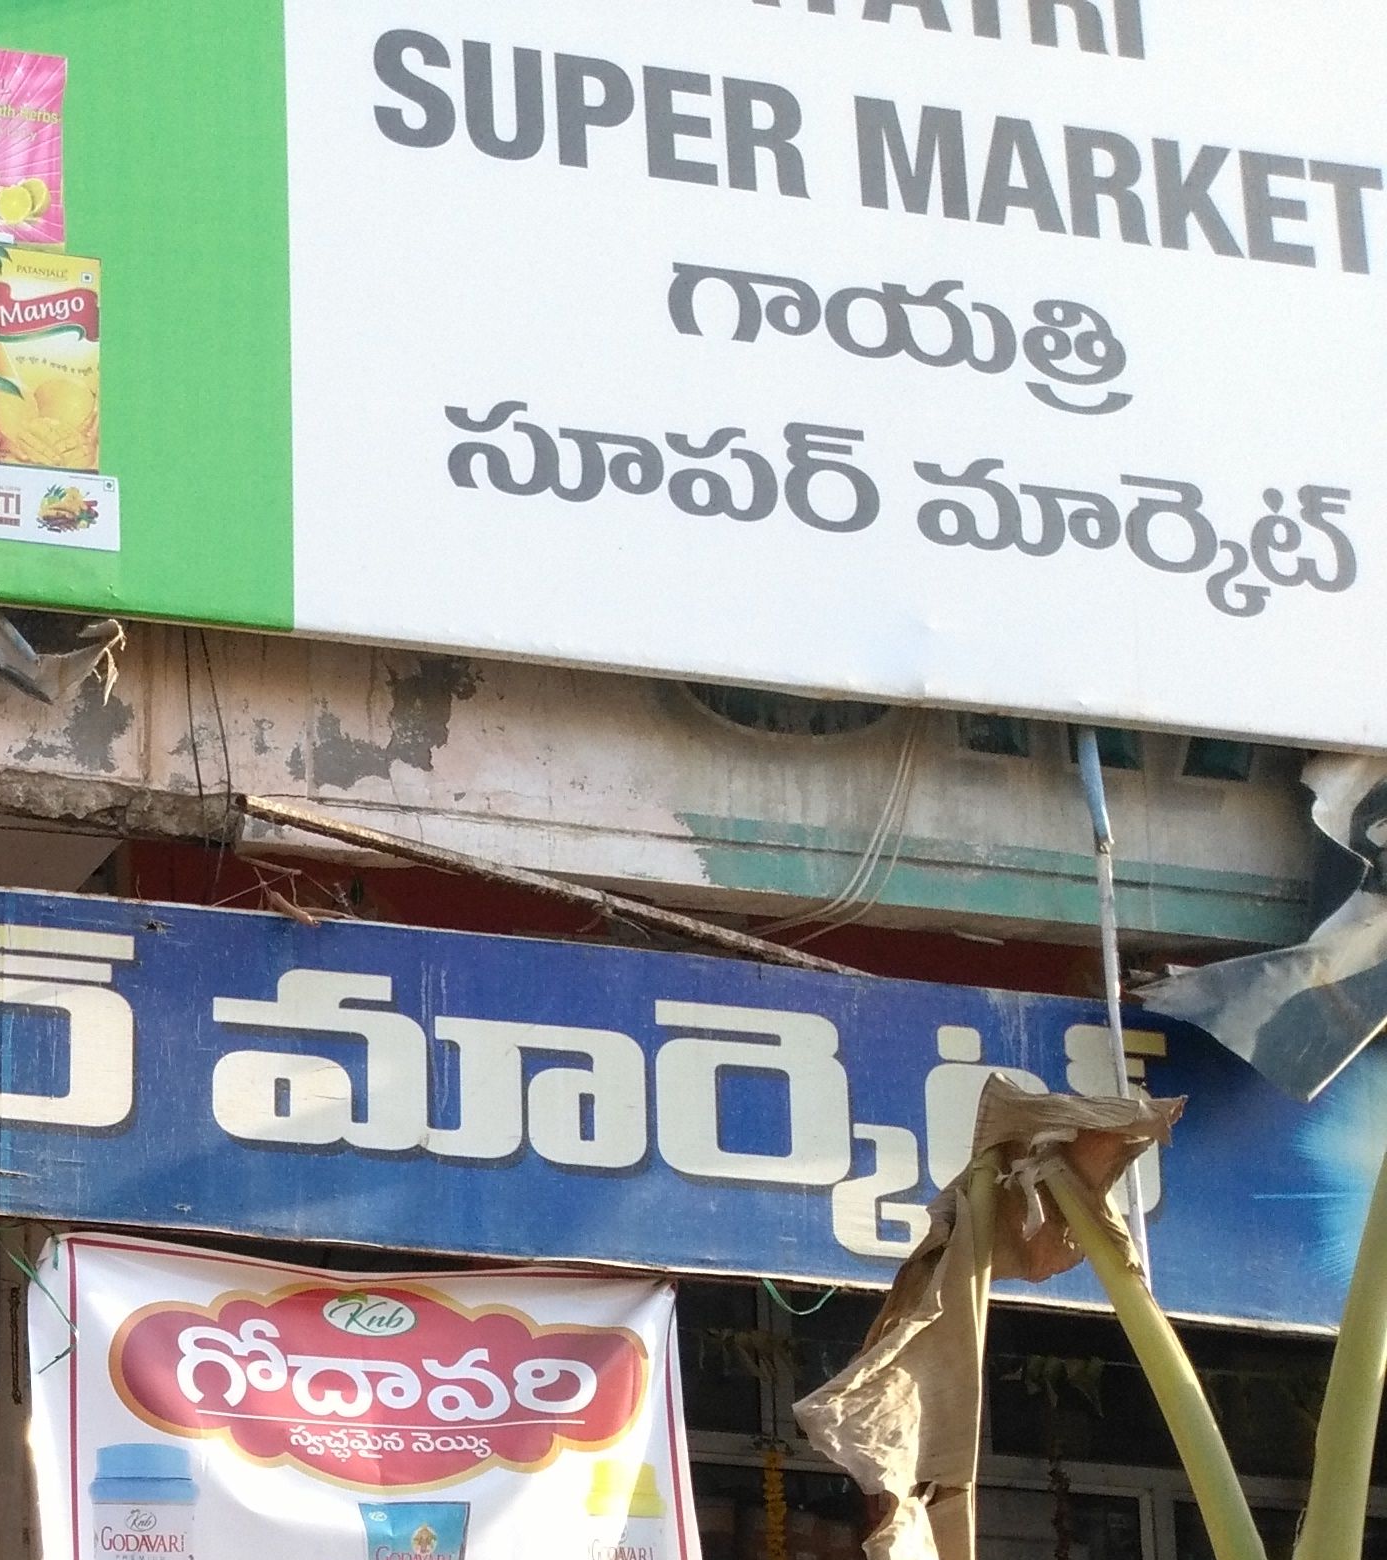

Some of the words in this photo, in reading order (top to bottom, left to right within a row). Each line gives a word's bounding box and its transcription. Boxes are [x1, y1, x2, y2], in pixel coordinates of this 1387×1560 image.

[18, 109, 59, 125] Herbs
[373, 29, 809, 199] SUPER
[852, 95, 1383, 275] MARKET
[16, 264, 66, 279] PATANJALI
[0, 295, 85, 327] Mango
[667, 261, 1134, 415] గాయత్రి
[443, 400, 881, 534] సూపర్
[912, 457, 1358, 617] మార్కెట్
[329, 1299, 407, 1332] Knb
[176, 1318, 598, 1423] గోదావరి
[100, 1526, 185, 1553] GODAVARI
